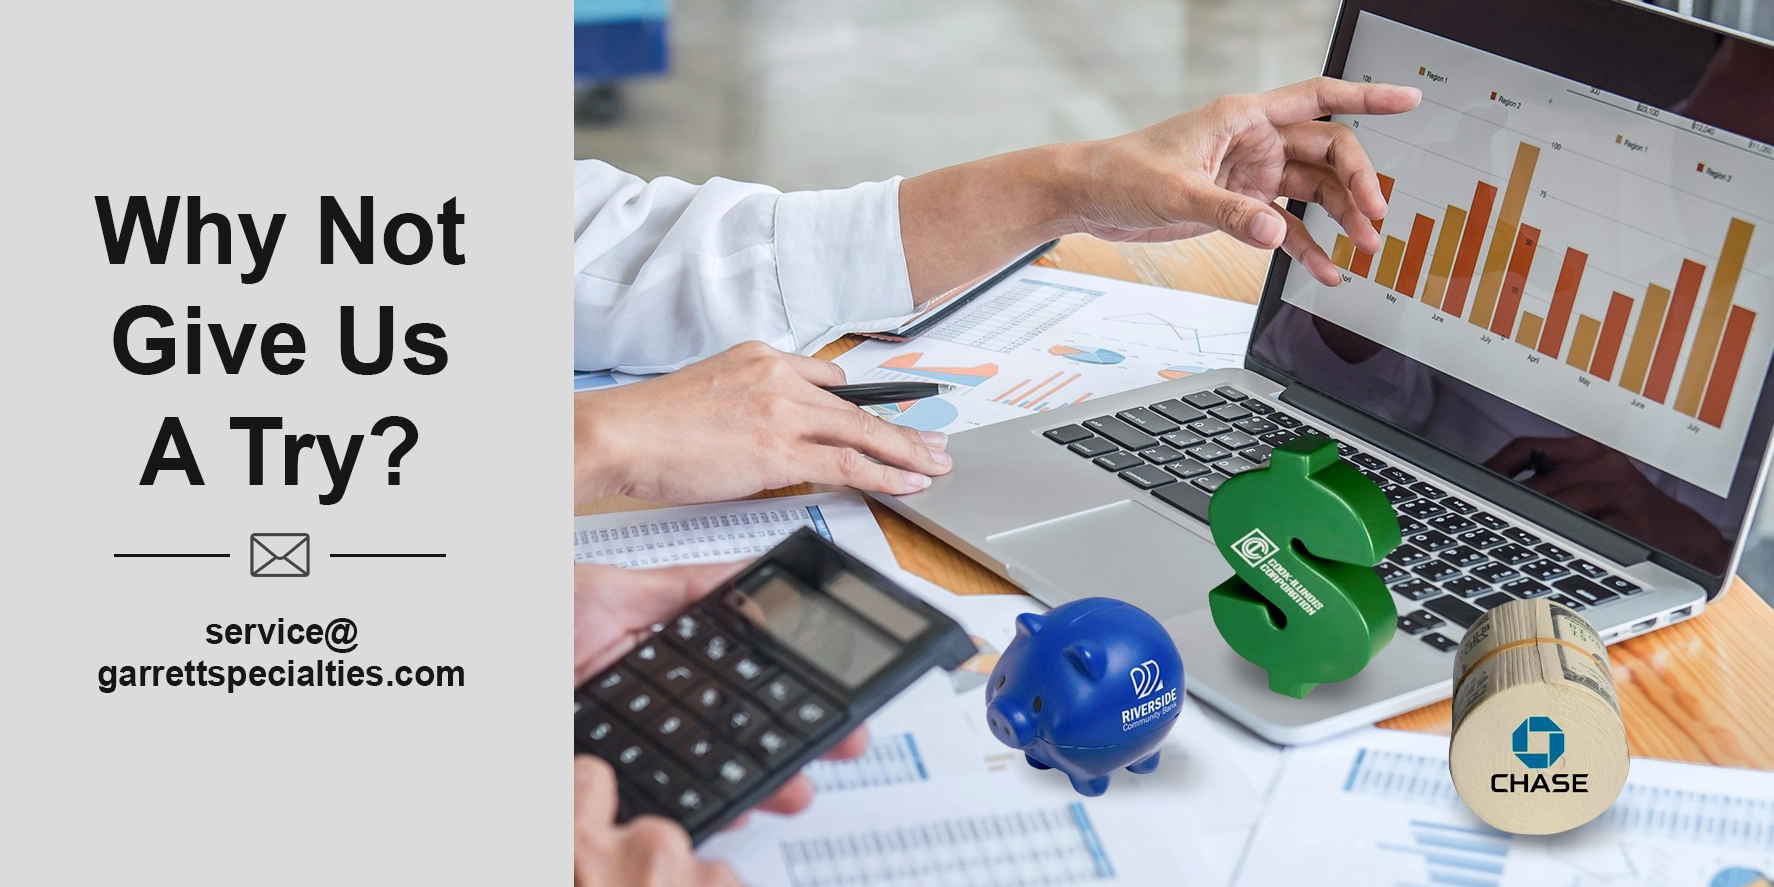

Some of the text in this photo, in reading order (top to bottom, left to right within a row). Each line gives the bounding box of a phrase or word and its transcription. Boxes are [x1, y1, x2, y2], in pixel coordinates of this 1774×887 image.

[1362, 74, 1372, 83] 100
[1426, 71, 1448, 84] Region 1
[1498, 95, 1516, 107] Region
[1352, 120, 1360, 129] 75
[1551, 141, 1562, 151] 100
[1623, 139, 1643, 152] Region
[1705, 168, 1732, 183] Region 2
[1539, 189, 1547, 198] 75
[1525, 238, 1533, 247] 50
[1511, 286, 1519, 295] 25
[1386, 292, 1397, 304] May
[1431, 313, 1444, 324] June
[1480, 333, 1492, 345] July
[1527, 353, 1540, 365] April
[1578, 375, 1591, 388] May
[1630, 398, 1645, 410] June
[1686, 422, 1700, 434] July
[1219, 434, 1233, 442] W
[1259, 563, 1317, 616] CORPORATION
[1267, 557, 1324, 610] COOK-ILLINOIS
[1122, 688, 1177, 723] RIVERSIDE
[1122, 702, 1177, 732] Community Bank
[1491, 774, 1588, 792] CHASE
